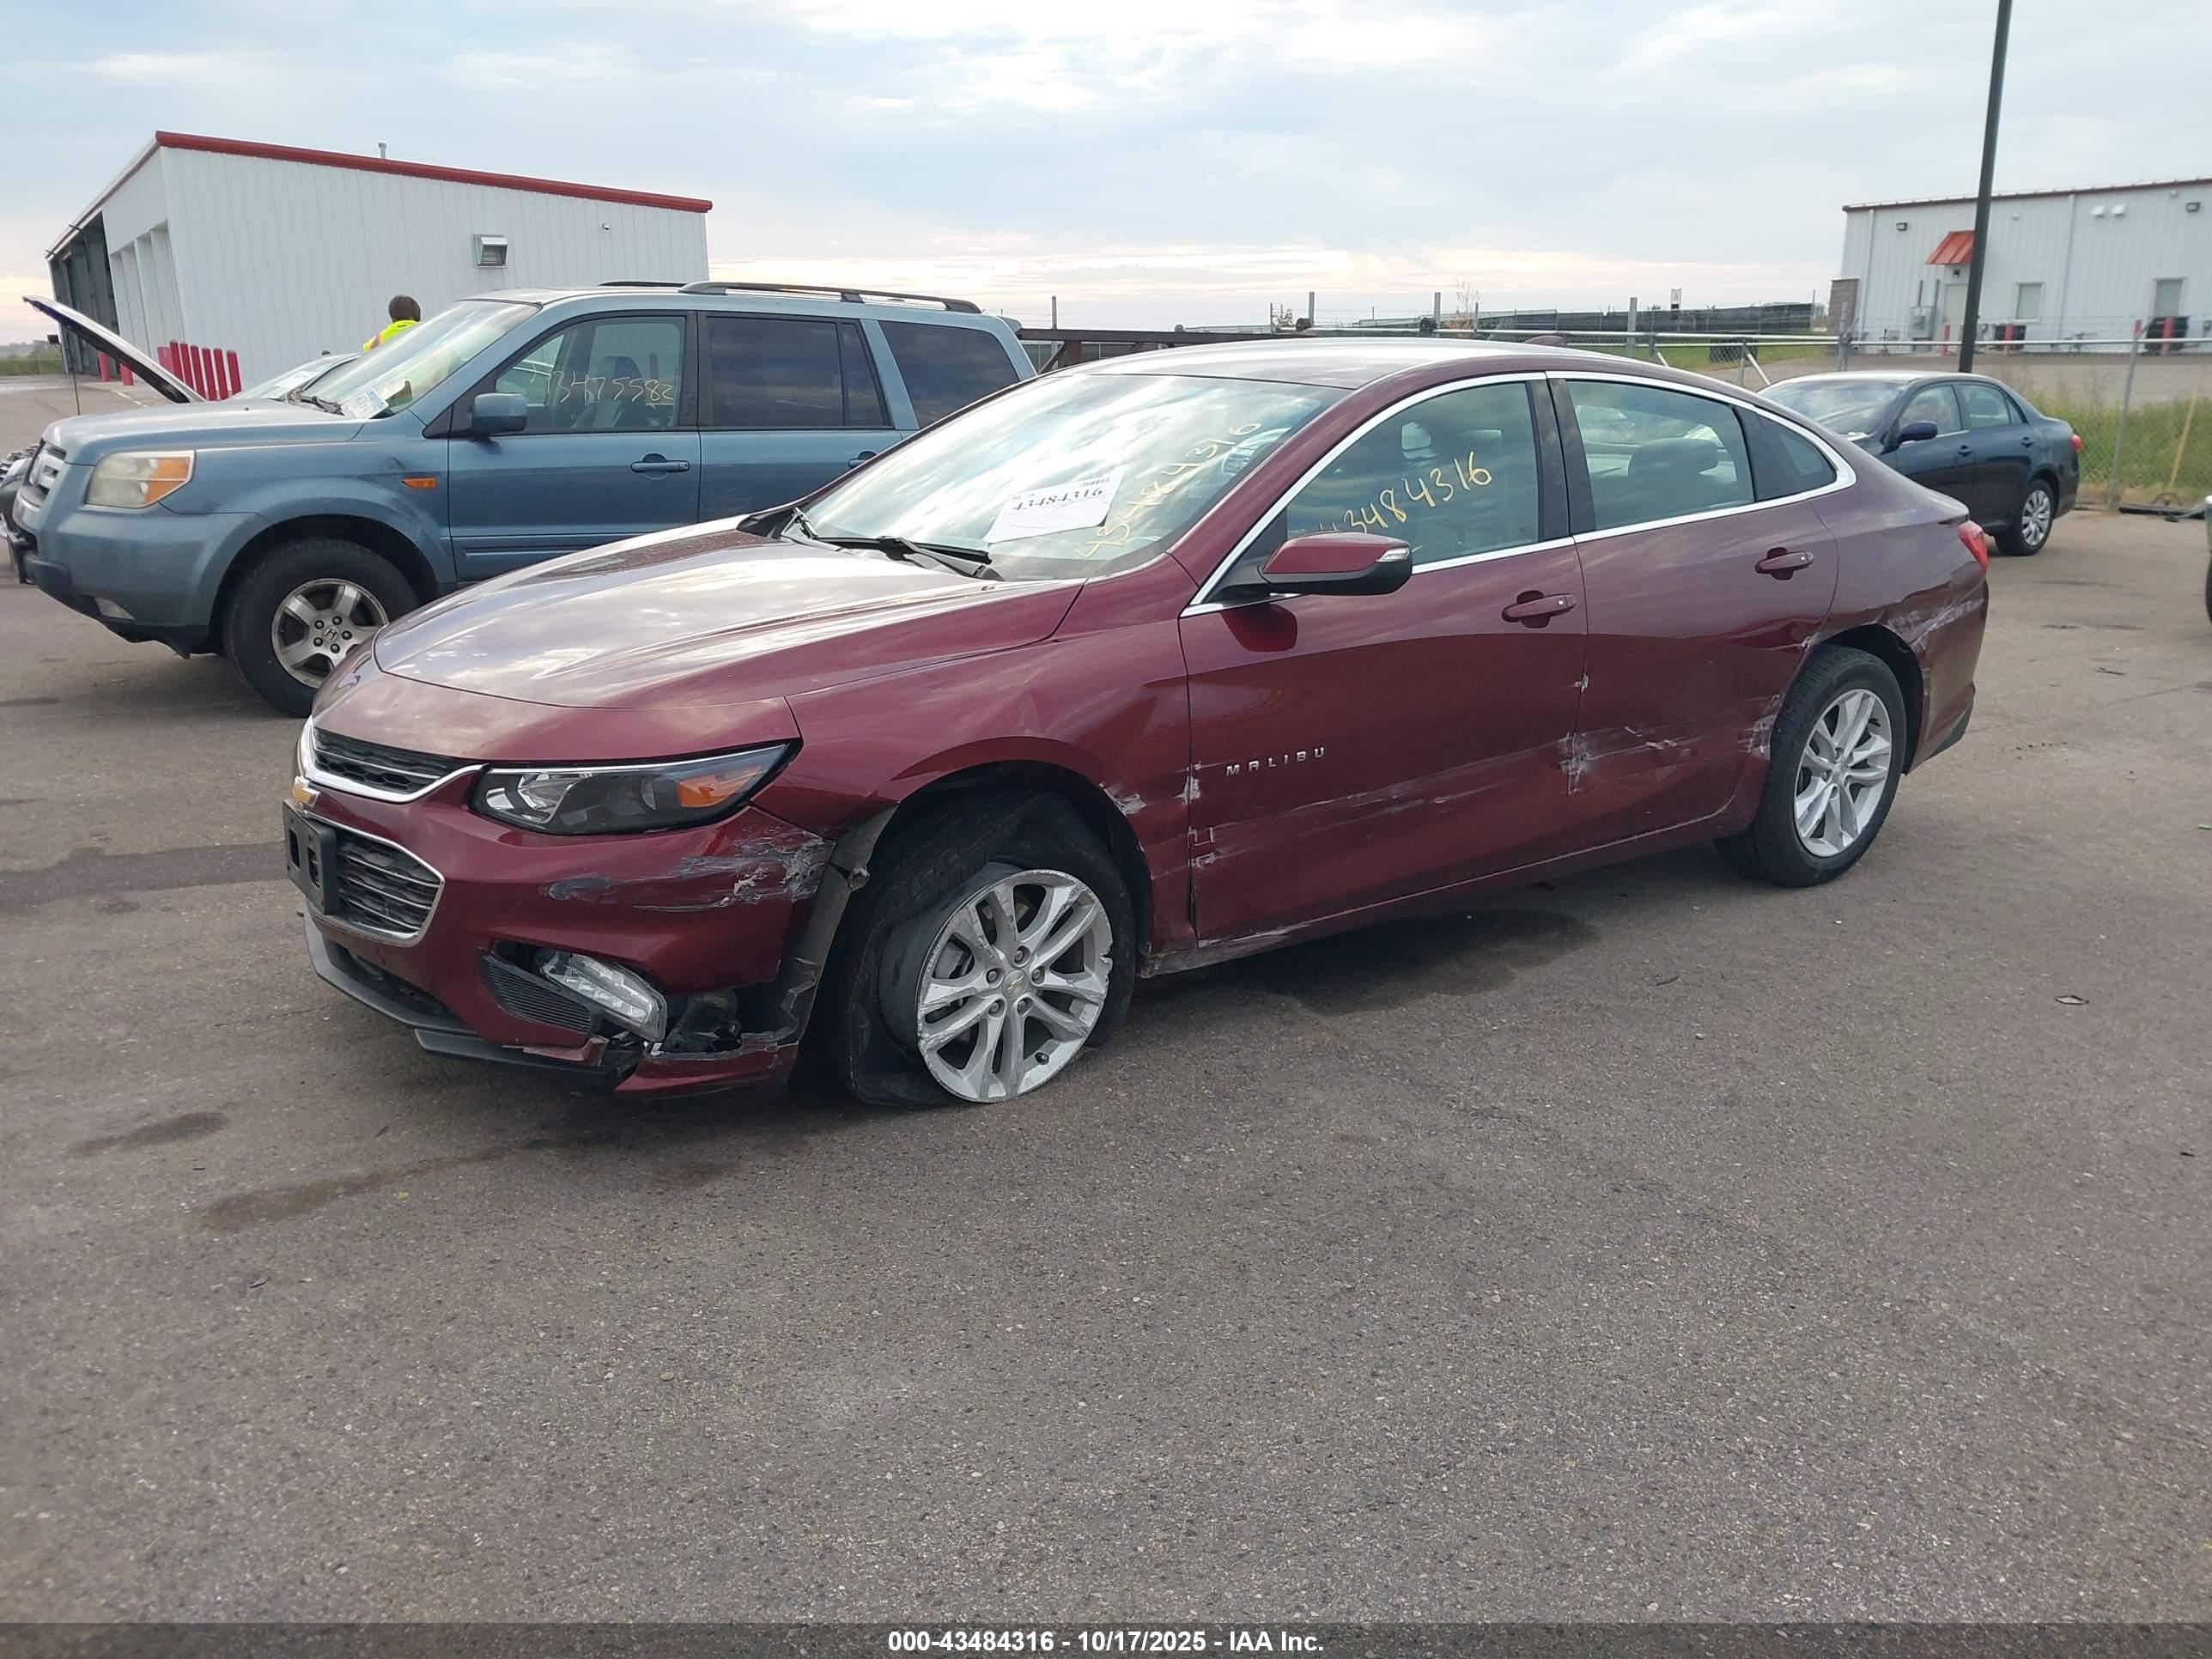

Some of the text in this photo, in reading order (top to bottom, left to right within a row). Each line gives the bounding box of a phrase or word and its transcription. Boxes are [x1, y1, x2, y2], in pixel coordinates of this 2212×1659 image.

[1012, 488, 1103, 512] 43484316
[1319, 451, 1492, 534] 3484316
[1225, 746, 1325, 777] MALIBU
